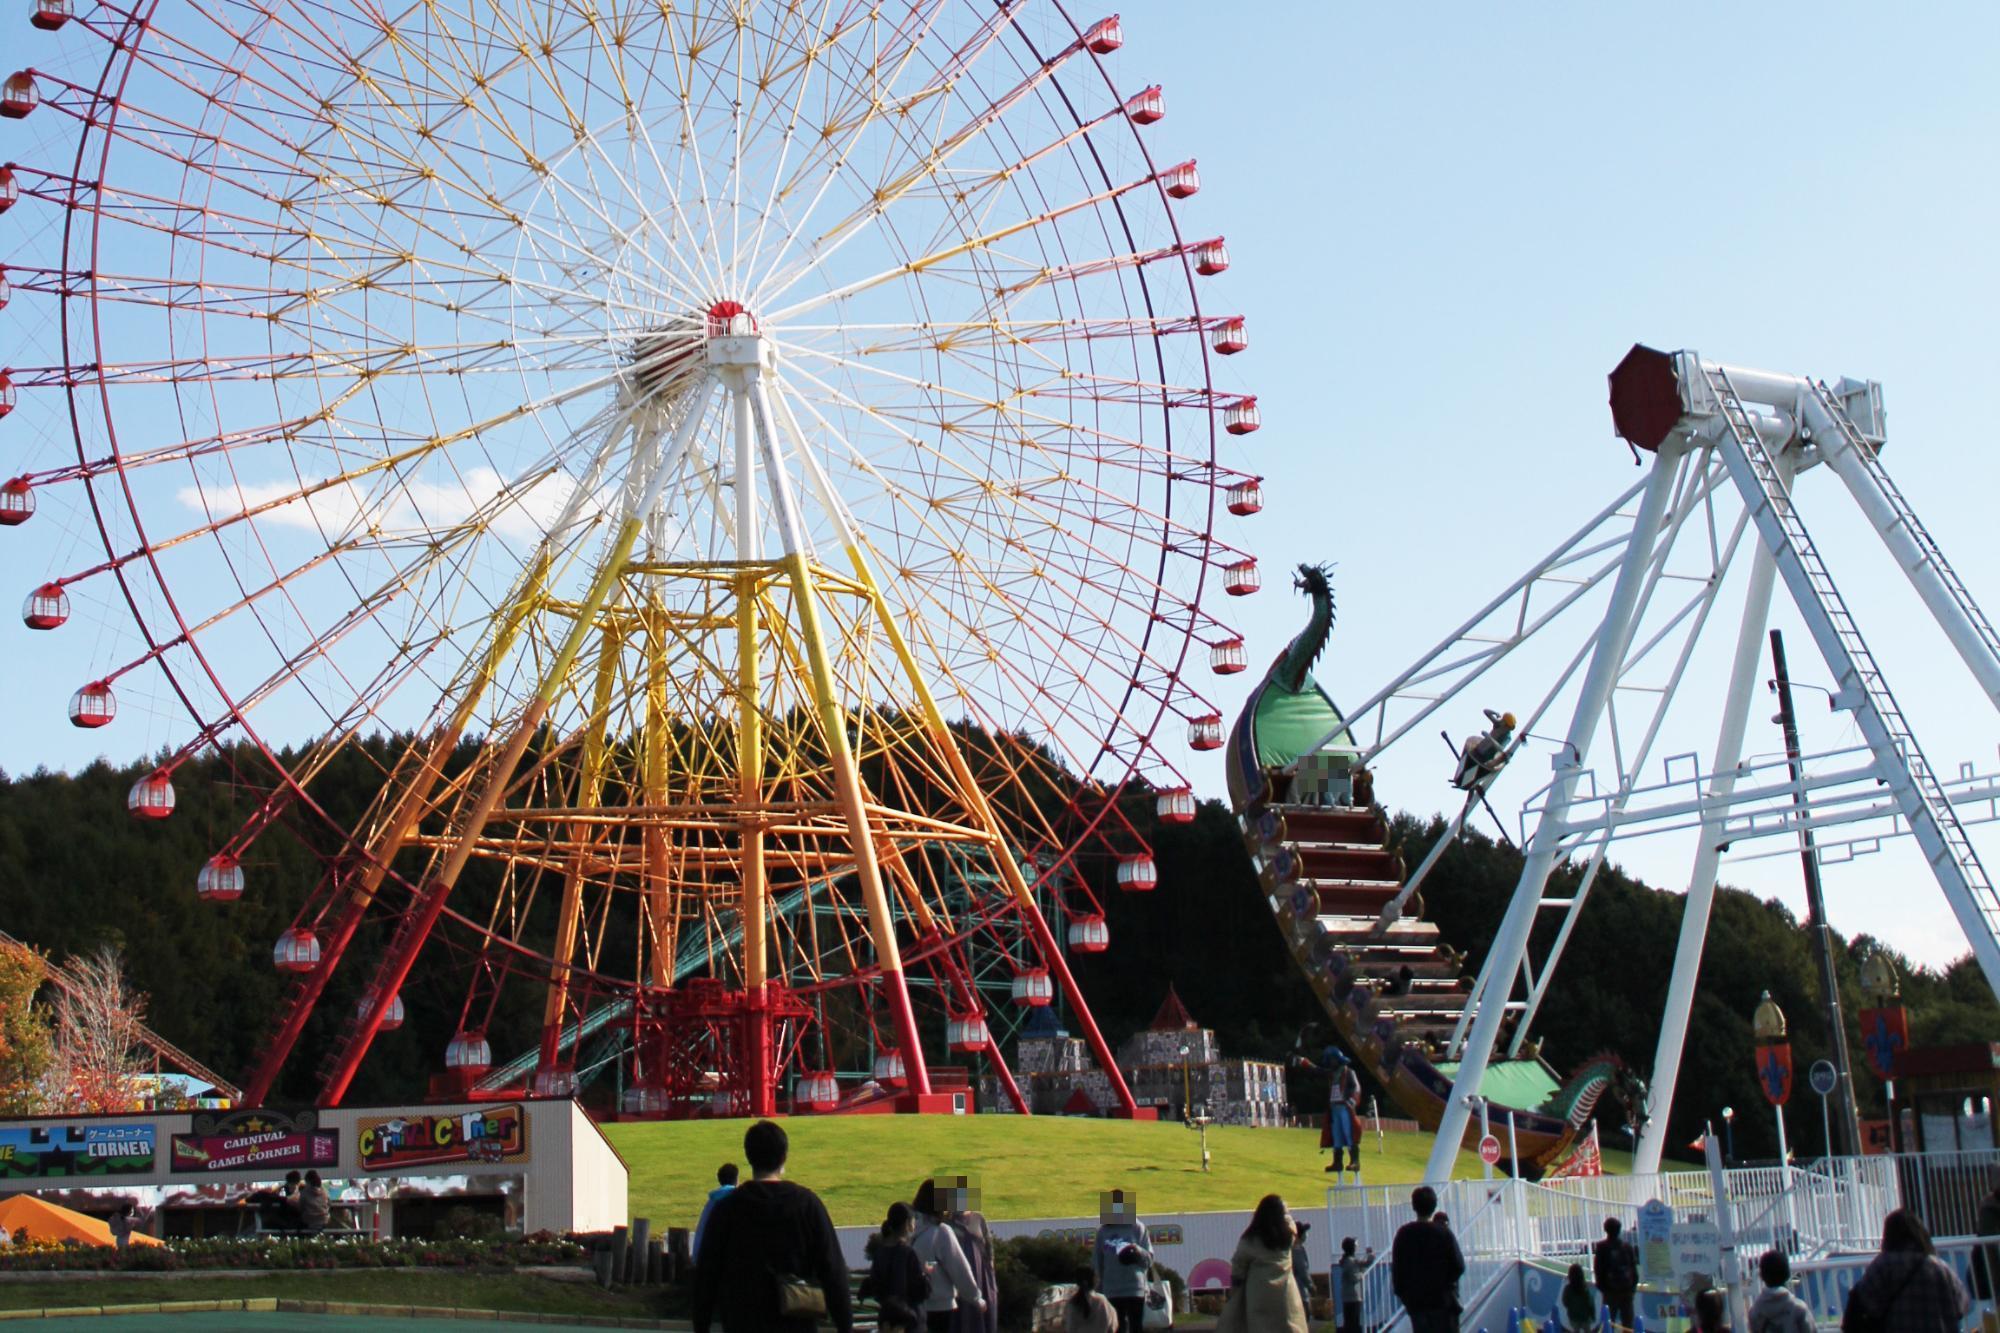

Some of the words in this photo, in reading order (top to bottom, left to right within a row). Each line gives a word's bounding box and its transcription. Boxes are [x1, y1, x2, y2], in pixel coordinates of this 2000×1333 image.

[89, 1129, 151, 1139] ゲームコーナー
[223, 1131, 286, 1150] CARNIVAL
[88, 1141, 150, 1157] CORNER
[208, 1153, 245, 1169] GAME
[247, 1145, 301, 1162] CORNER
